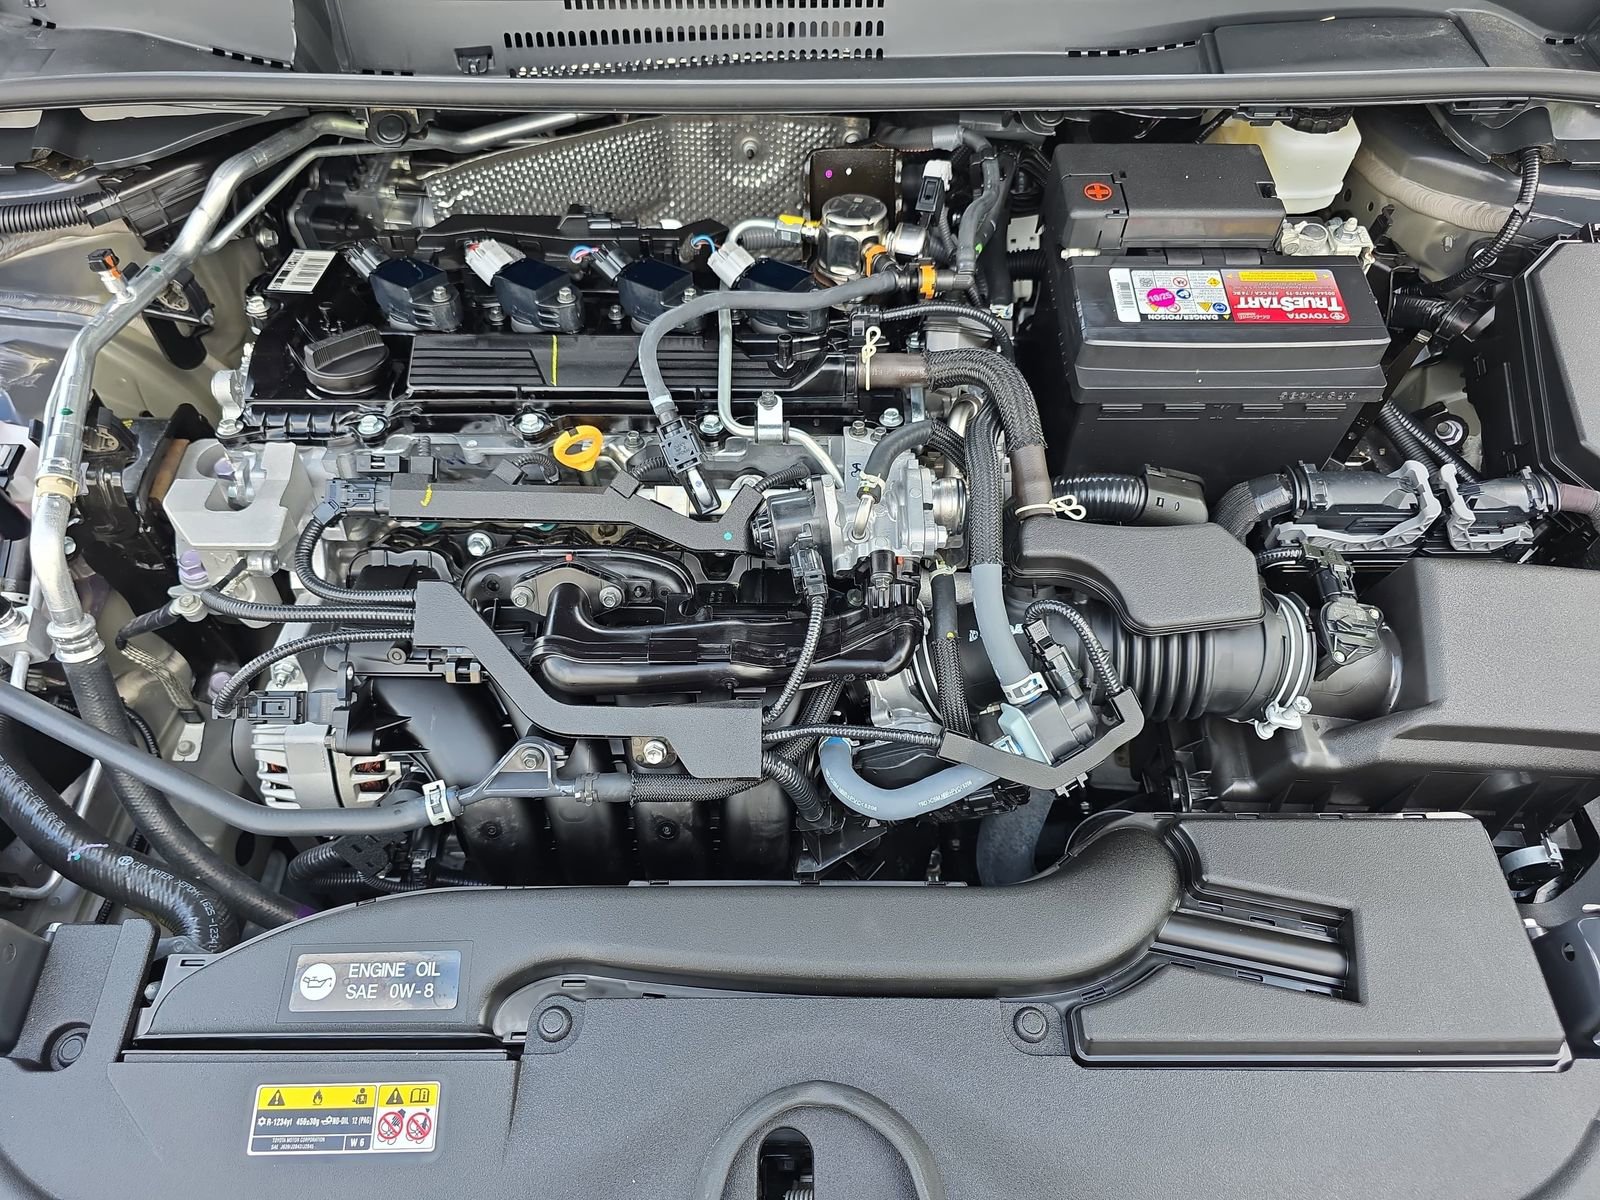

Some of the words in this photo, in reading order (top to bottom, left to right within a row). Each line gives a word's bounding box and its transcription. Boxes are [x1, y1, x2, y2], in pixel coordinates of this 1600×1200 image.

[1286, 312, 1329, 320] TOYOTA
[348, 962, 406, 978] ENGINE
[415, 961, 441, 977] OIL
[345, 984, 379, 999] SAE
[389, 983, 434, 999] 0W-8
[266, 1117, 293, 1127] R-1234yf
[352, 1116, 358, 1125] 12
[350, 1138, 358, 1147] W
[359, 1137, 365, 1147] 6
